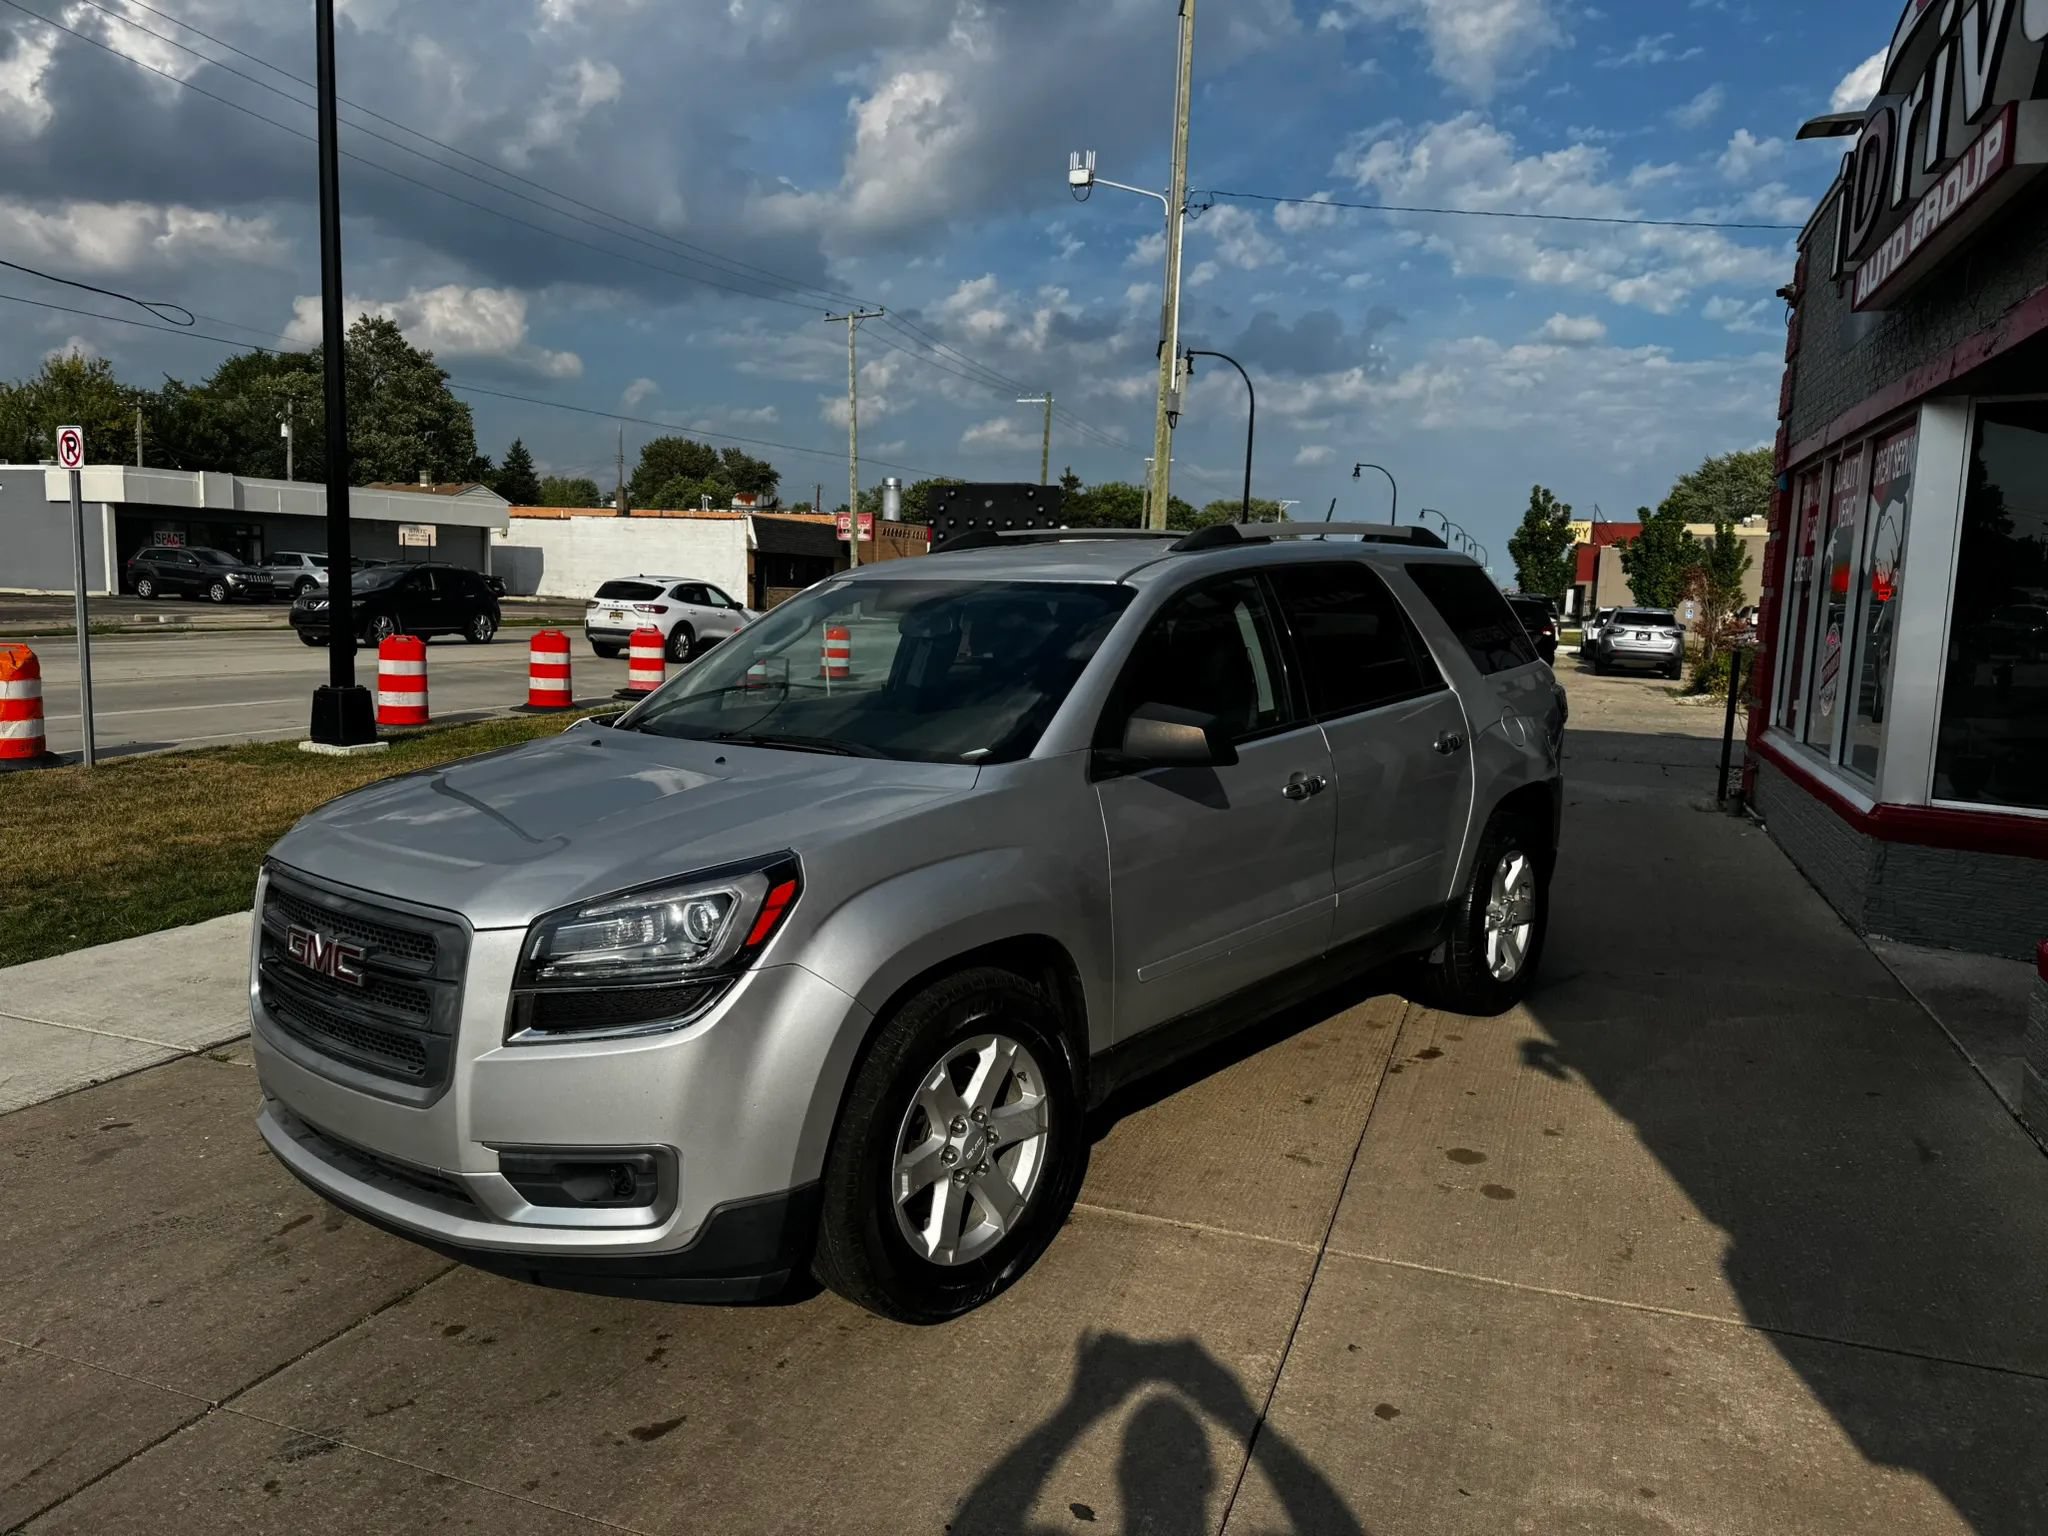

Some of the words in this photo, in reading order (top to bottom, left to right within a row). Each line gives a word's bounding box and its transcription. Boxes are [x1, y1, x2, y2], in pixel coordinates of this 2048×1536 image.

[1855, 223, 1906, 305] AUTO
[1909, 119, 2003, 252] GROUP
[154, 532, 185, 546] SPACE
[286, 924, 365, 987] GMC
